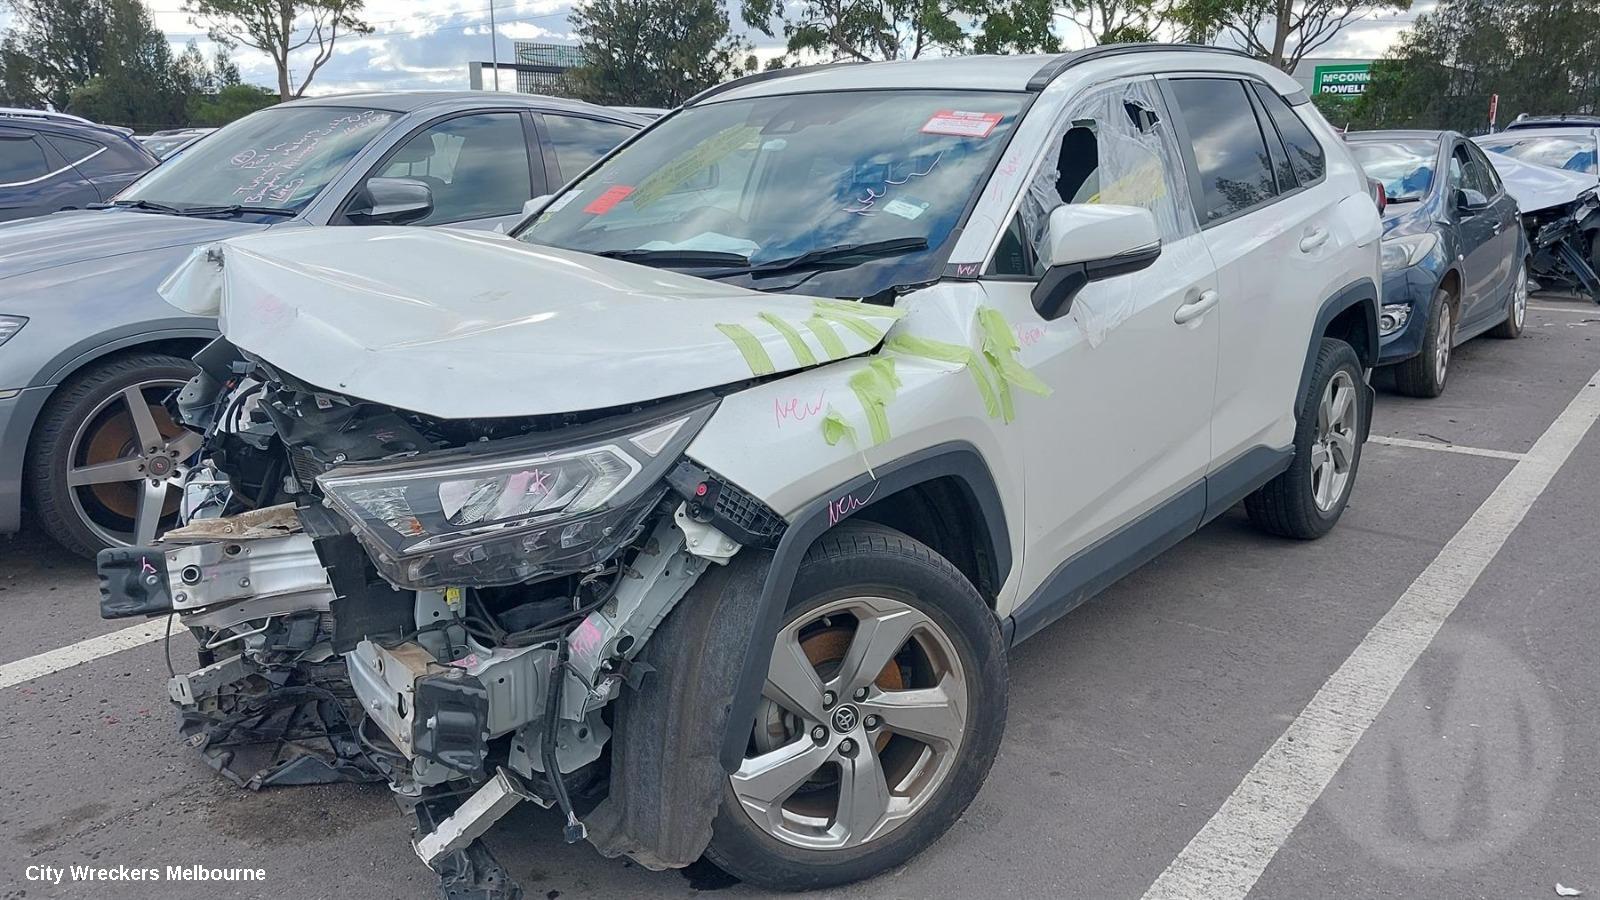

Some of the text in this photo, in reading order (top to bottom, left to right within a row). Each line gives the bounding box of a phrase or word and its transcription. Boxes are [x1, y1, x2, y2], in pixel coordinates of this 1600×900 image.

[1322, 84, 1367, 93] DOWELL
[842, 151, 944, 217] New
[775, 388, 826, 429] New
[828, 480, 881, 528] New
